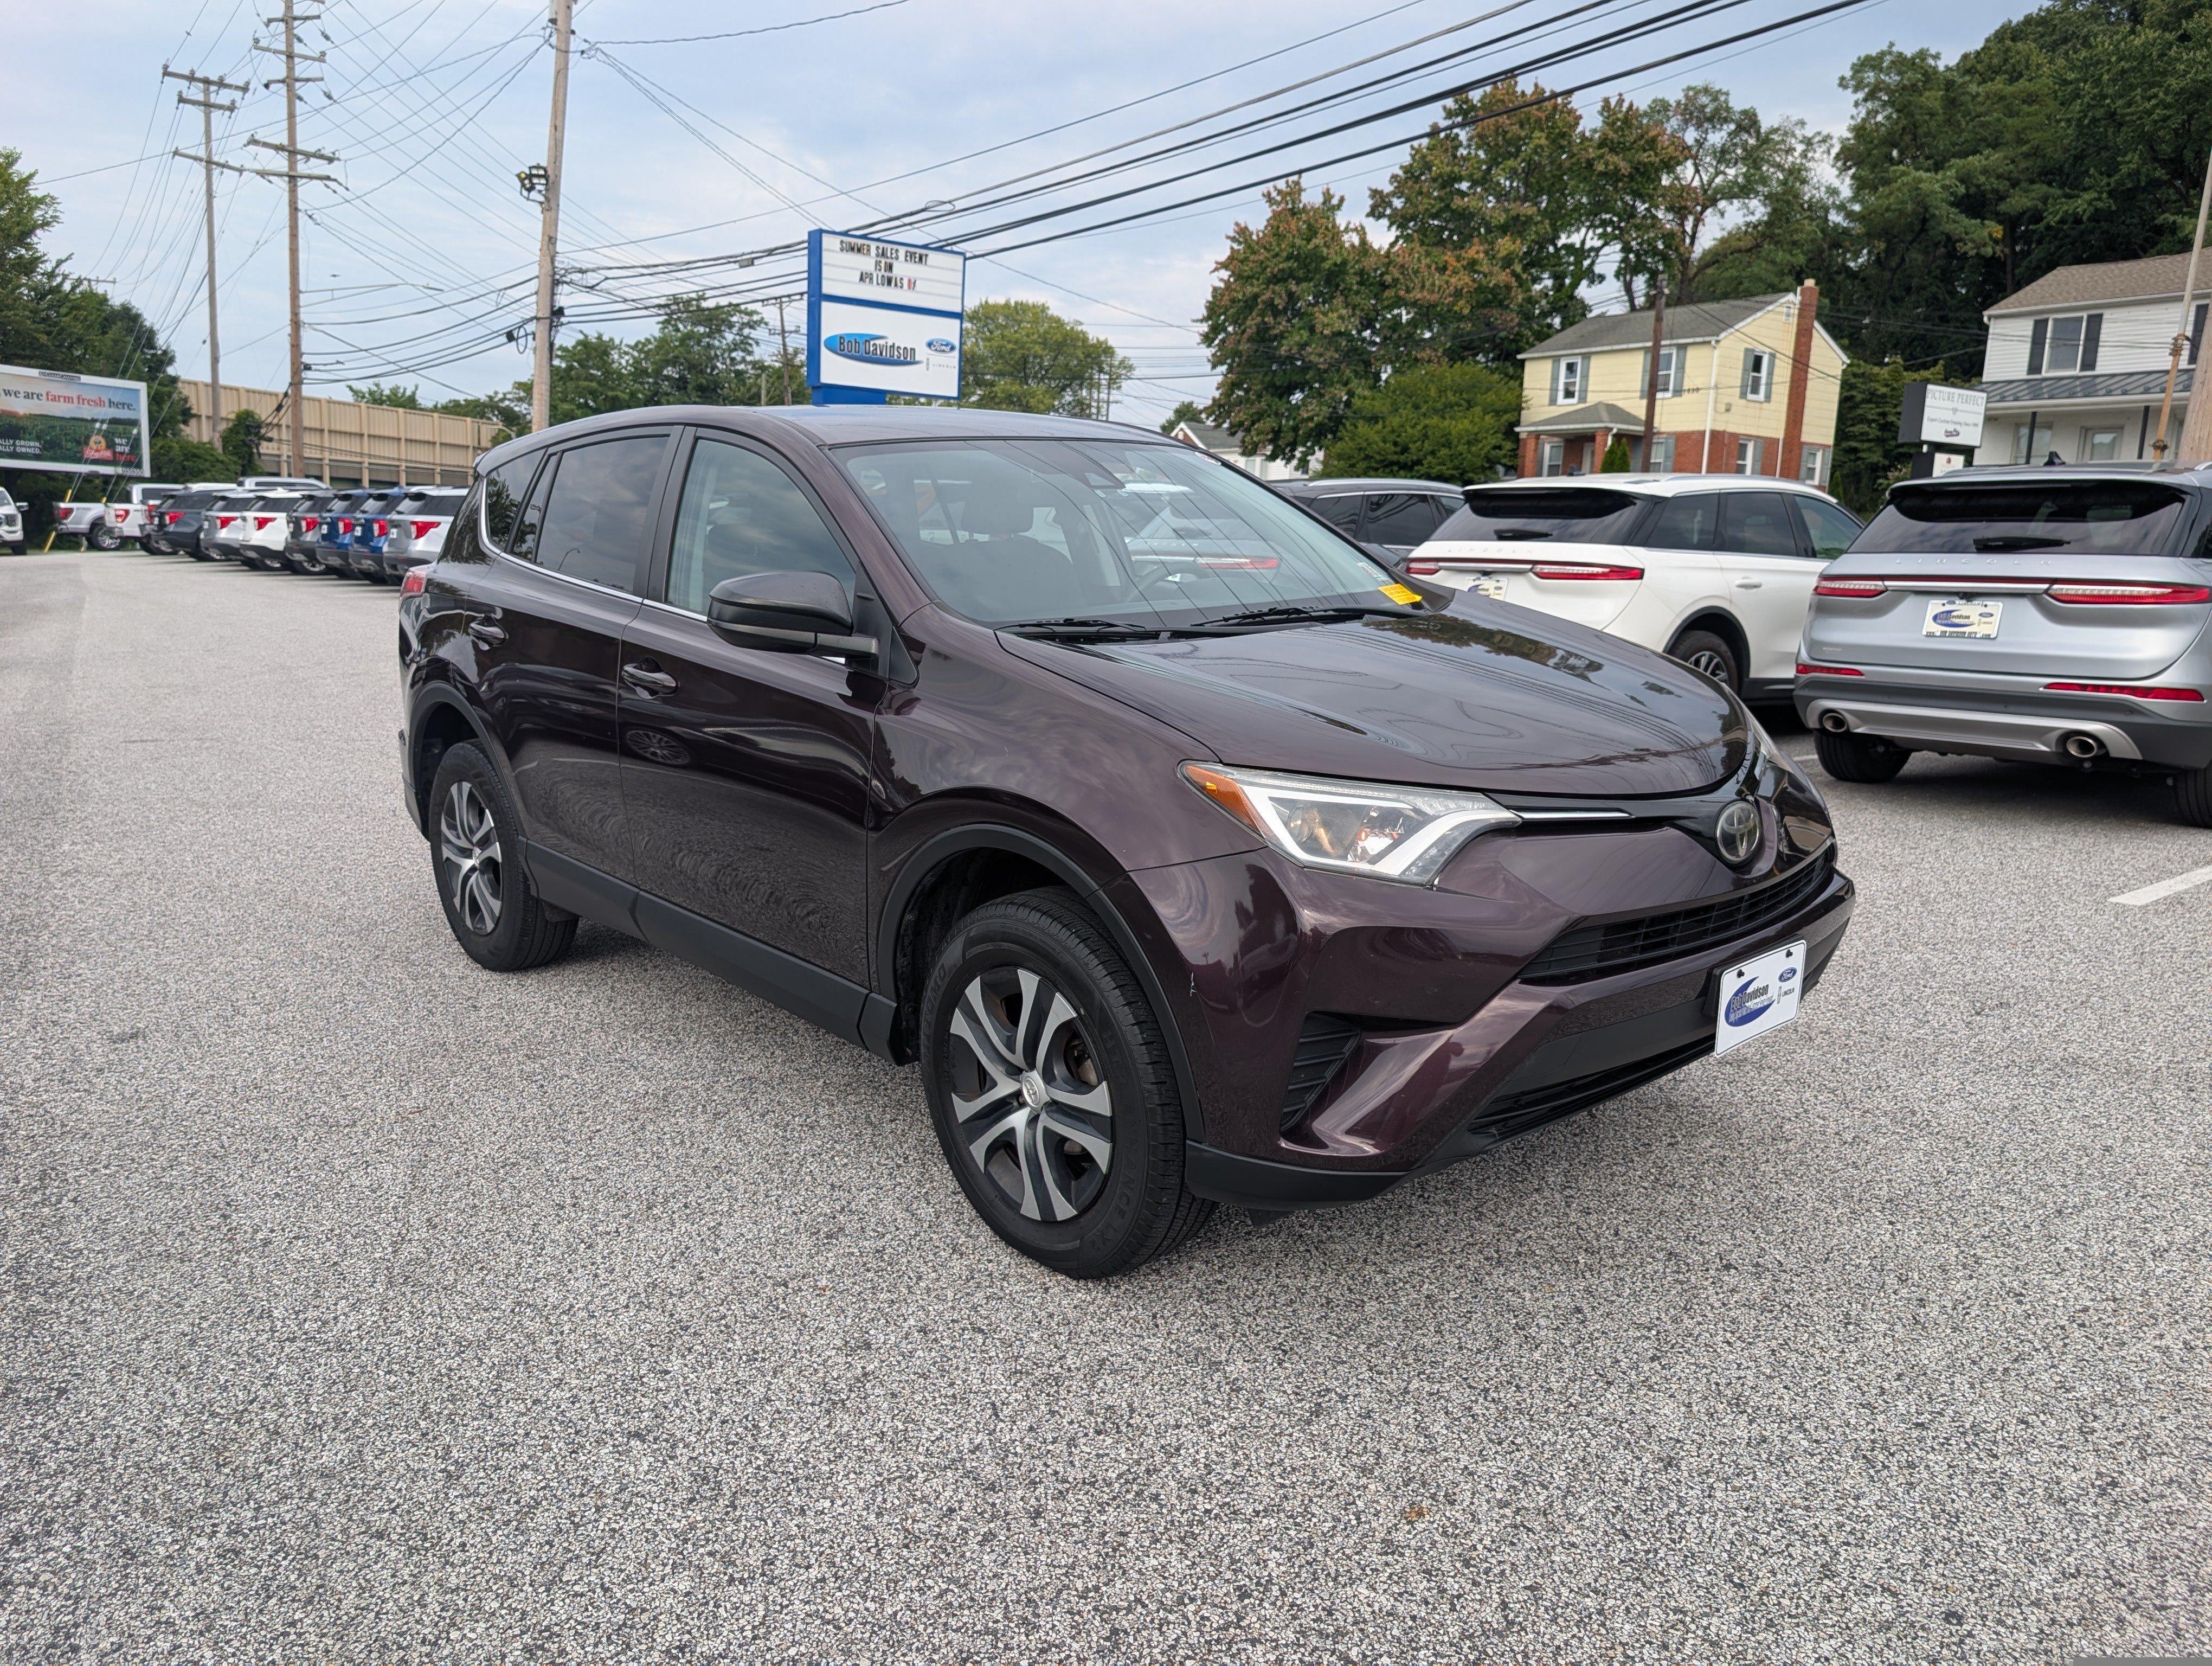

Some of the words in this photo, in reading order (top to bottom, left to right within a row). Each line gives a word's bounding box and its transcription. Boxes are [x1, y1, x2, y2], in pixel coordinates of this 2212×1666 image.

[840, 240, 871, 256] SUMMER
[876, 246, 899, 260] SALES
[905, 250, 929, 265] EVENT
[859, 271, 873, 284] APR
[875, 259, 882, 271] IS
[884, 261, 893, 273] ON
[839, 336, 860, 354] Bob
[864, 339, 915, 361] Davidson
[3, 388, 21, 398] we
[23, 390, 43, 401] are
[46, 390, 74, 405] farm
[76, 394, 106, 407] fresh
[108, 398, 136, 411] here.
[1926, 389, 1955, 402] PICTURE
[1957, 392, 1984, 407] PERFECT
[1731, 992, 1743, 1010] Bob
[1742, 984, 1769, 1005] Davidson
